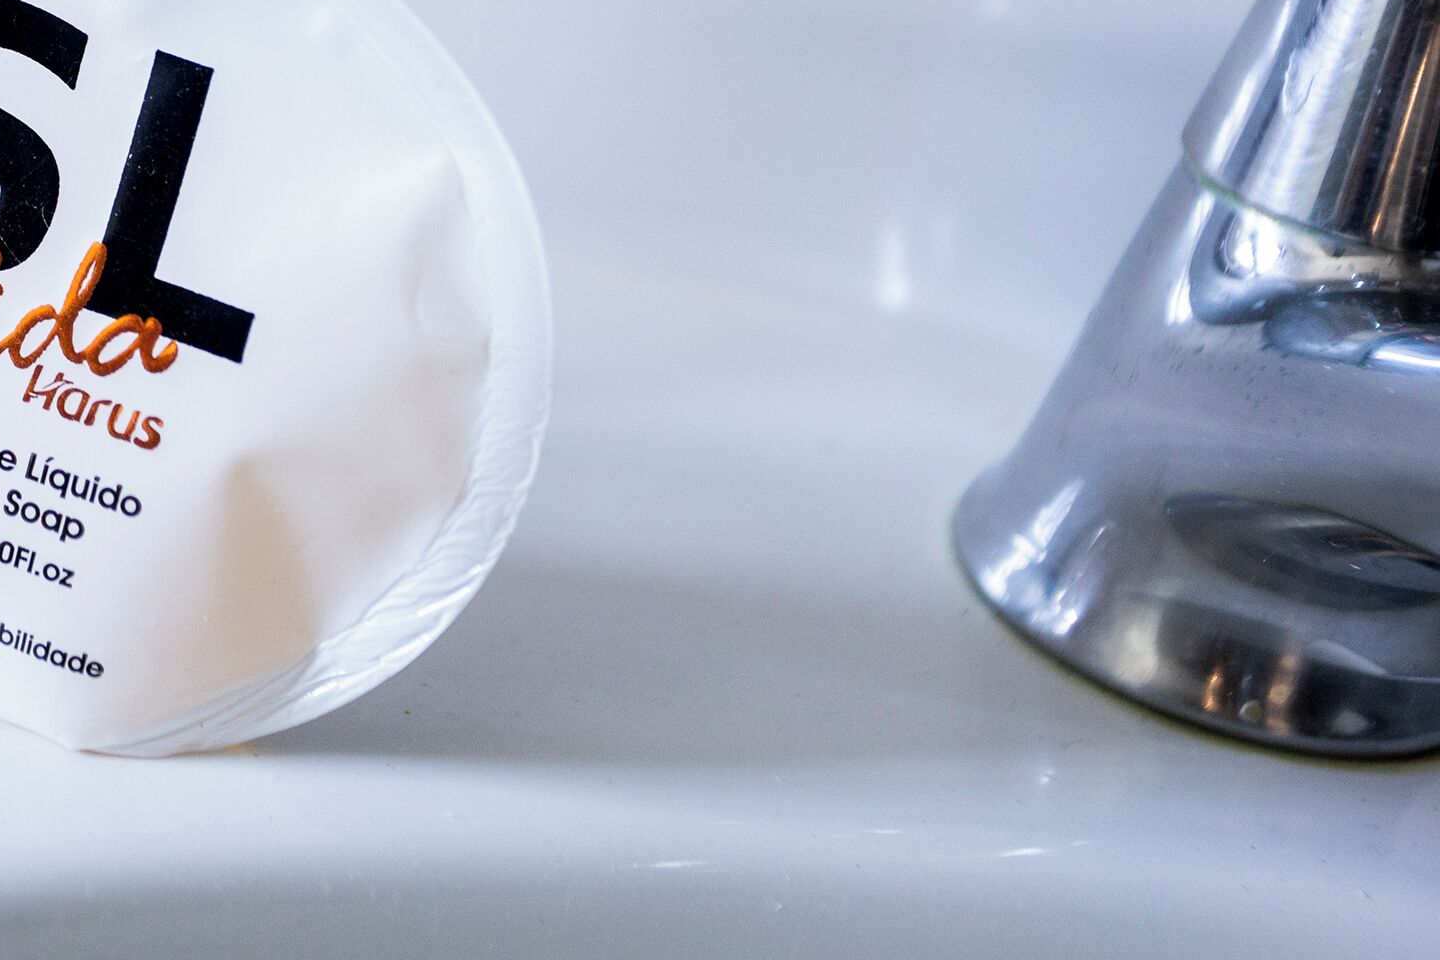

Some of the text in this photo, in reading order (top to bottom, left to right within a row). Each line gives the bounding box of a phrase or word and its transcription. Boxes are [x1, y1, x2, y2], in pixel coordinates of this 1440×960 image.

[22, 364, 165, 451] Harus
[3, 489, 85, 543] Soap
[24, 452, 143, 518] Líquido
